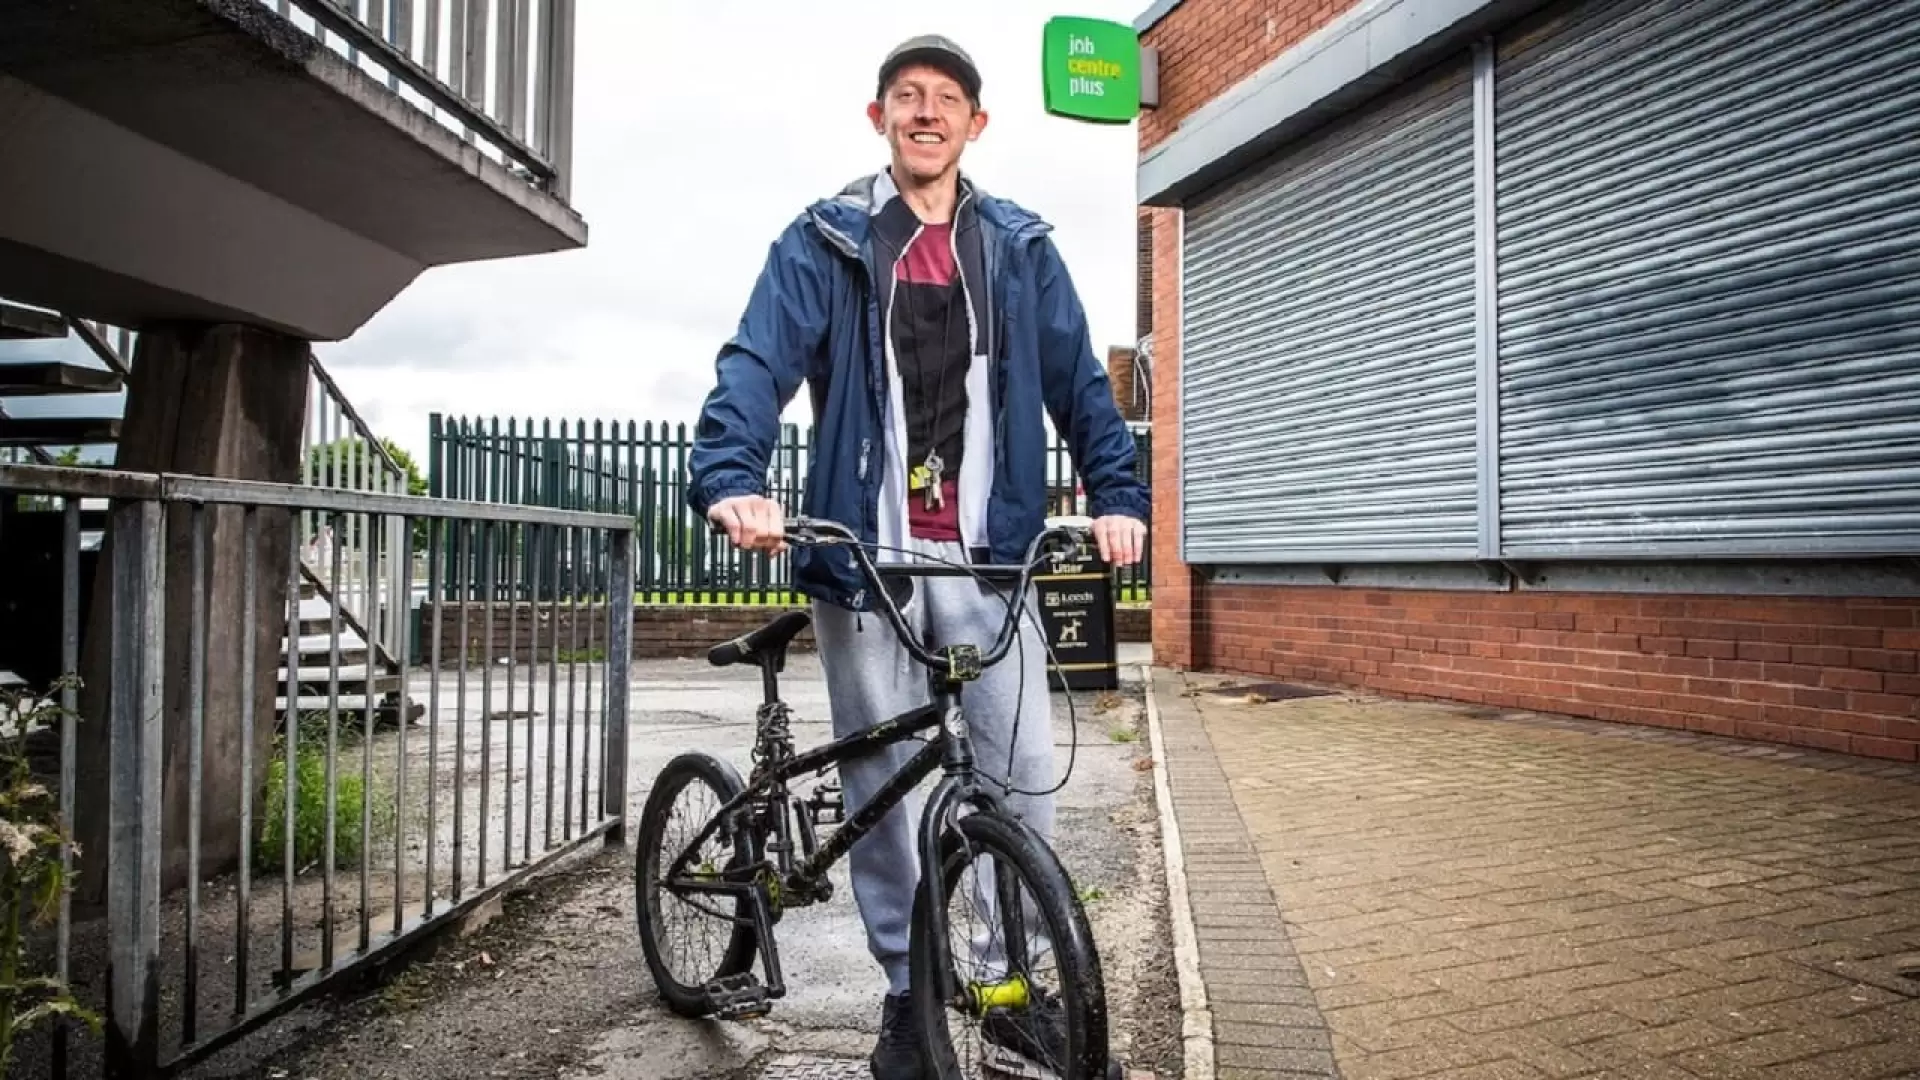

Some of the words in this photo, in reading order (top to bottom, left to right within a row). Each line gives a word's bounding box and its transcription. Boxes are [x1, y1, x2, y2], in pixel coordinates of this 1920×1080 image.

[1068, 34, 1095, 55] job
[1068, 59, 1121, 76] centre
[1070, 77, 1104, 97] plus
[1052, 563, 1083, 574] Litter
